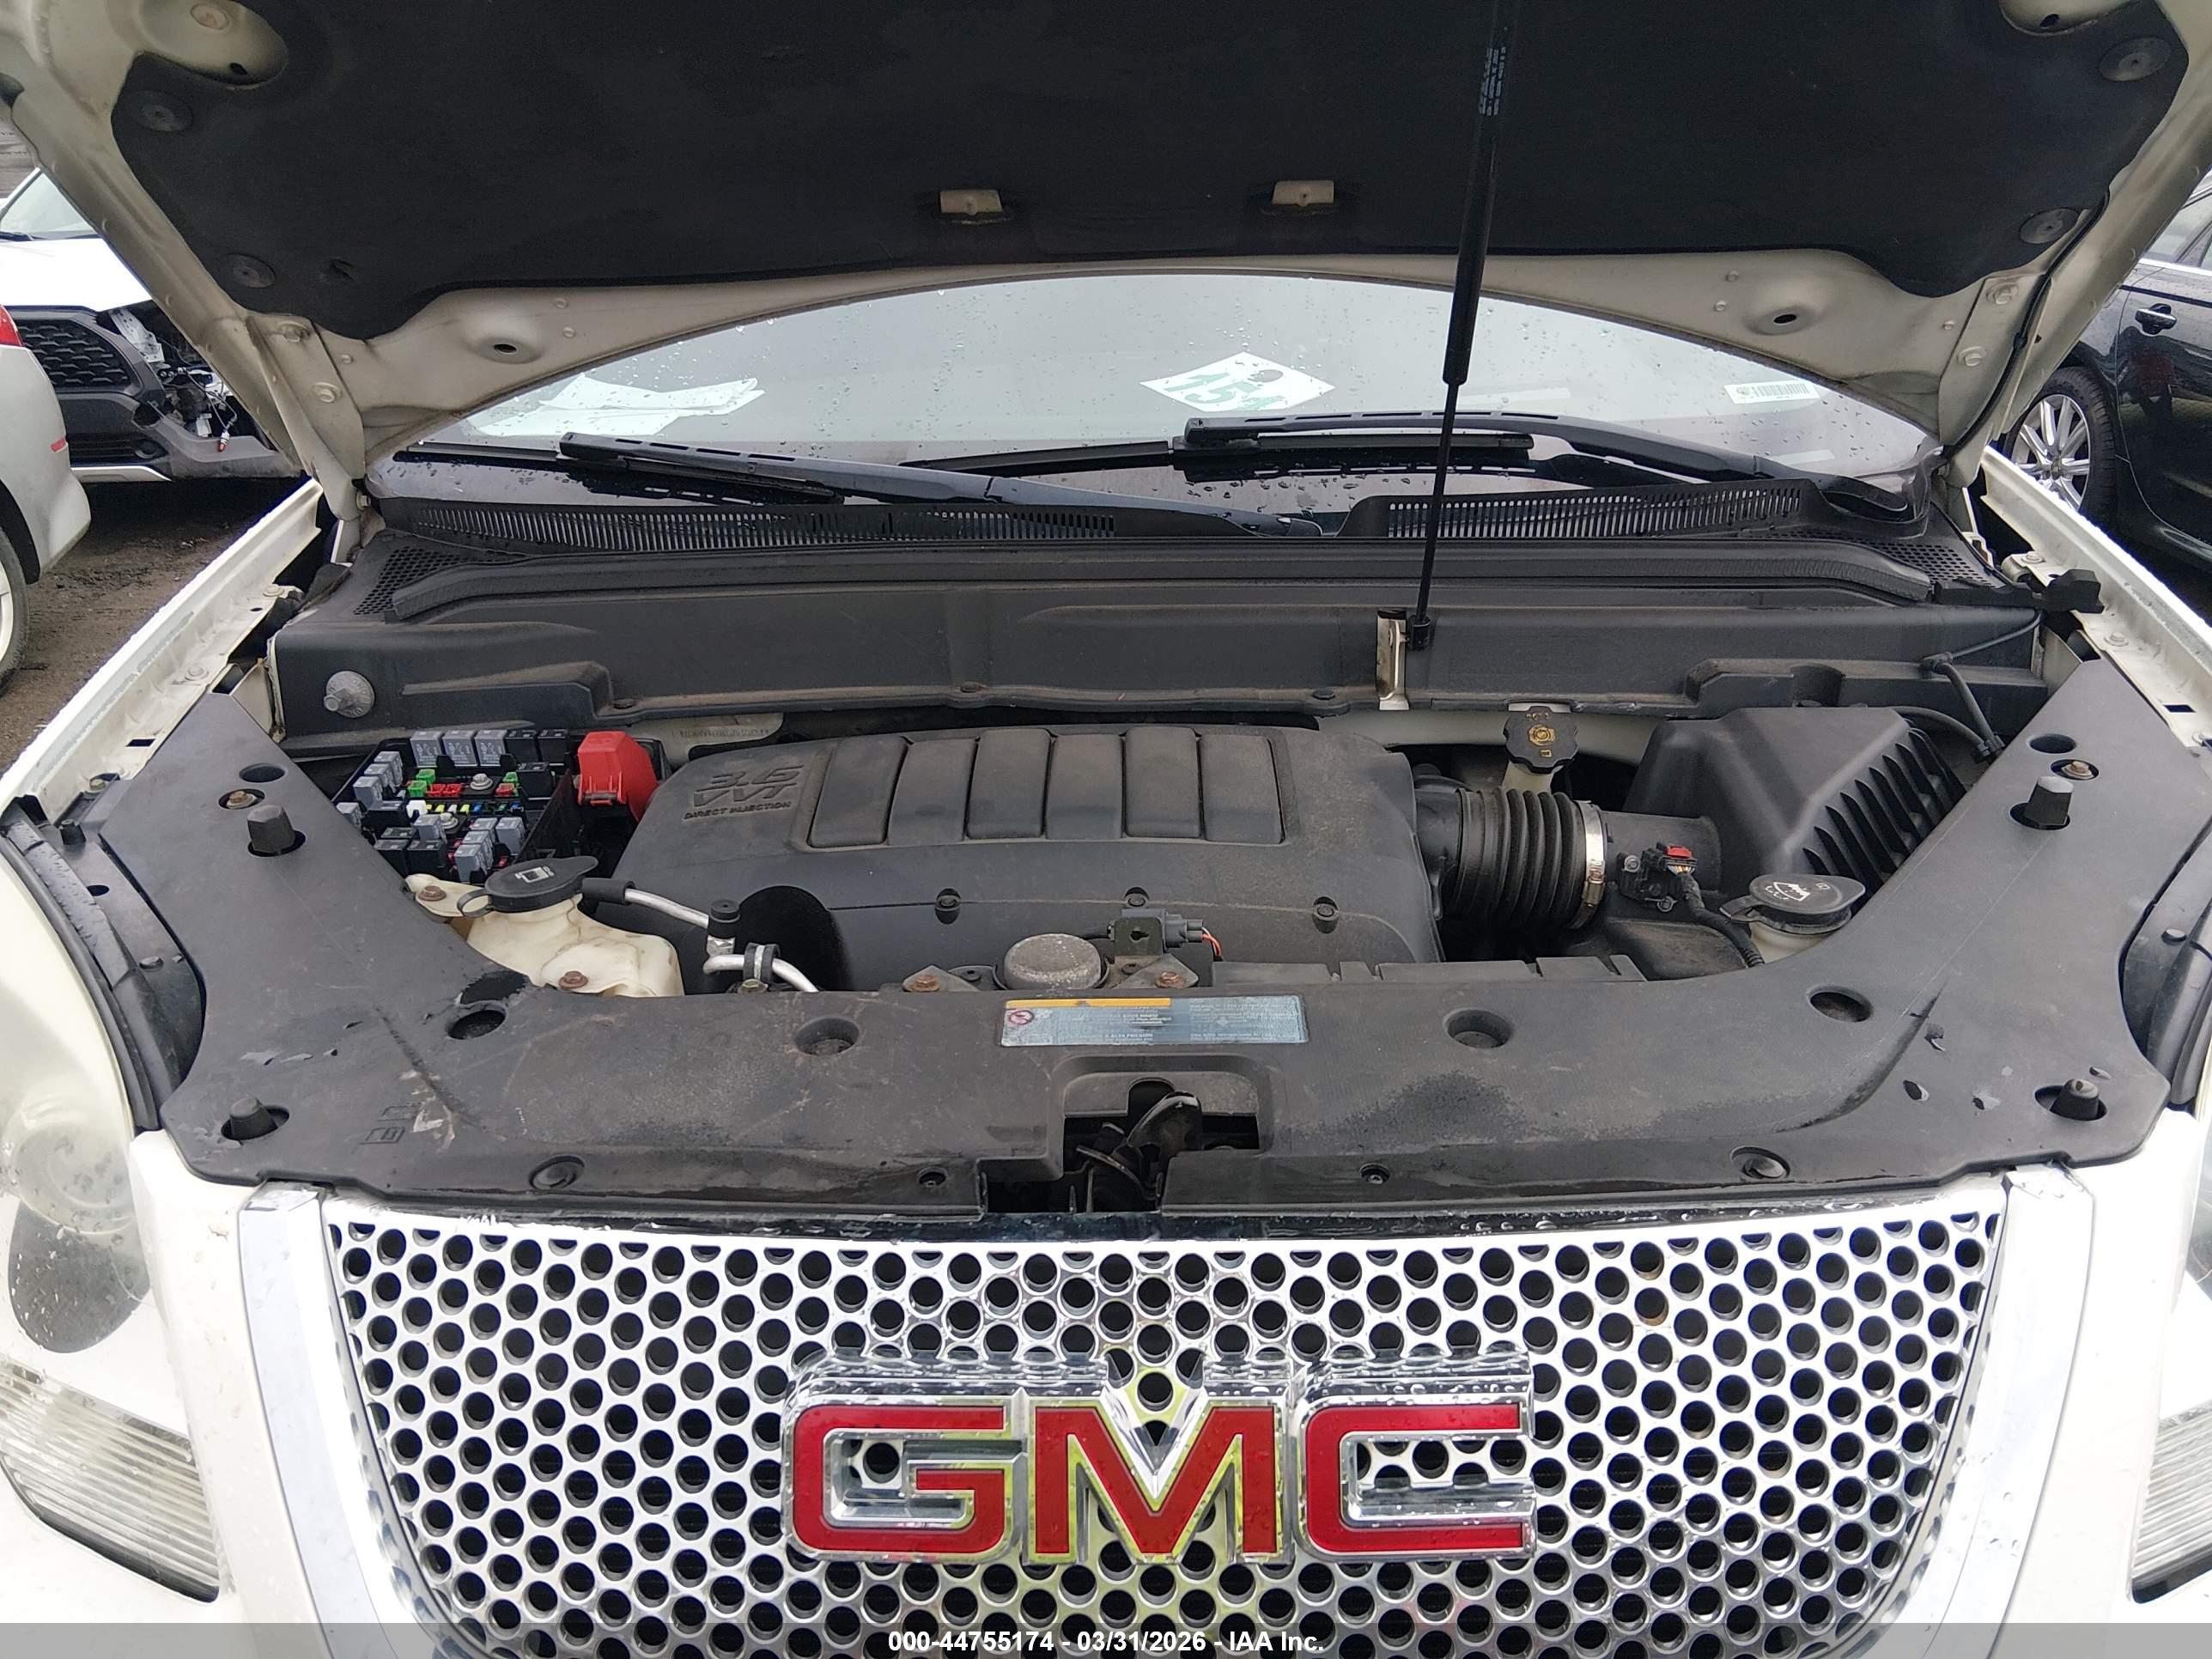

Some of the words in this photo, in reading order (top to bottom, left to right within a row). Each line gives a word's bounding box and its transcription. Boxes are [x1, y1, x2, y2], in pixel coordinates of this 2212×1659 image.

[696, 763, 804, 792] 3.6
[684, 807, 728, 820] DIRECT
[729, 801, 792, 814] INJECTION
[783, 1393, 1537, 1565] GMC
